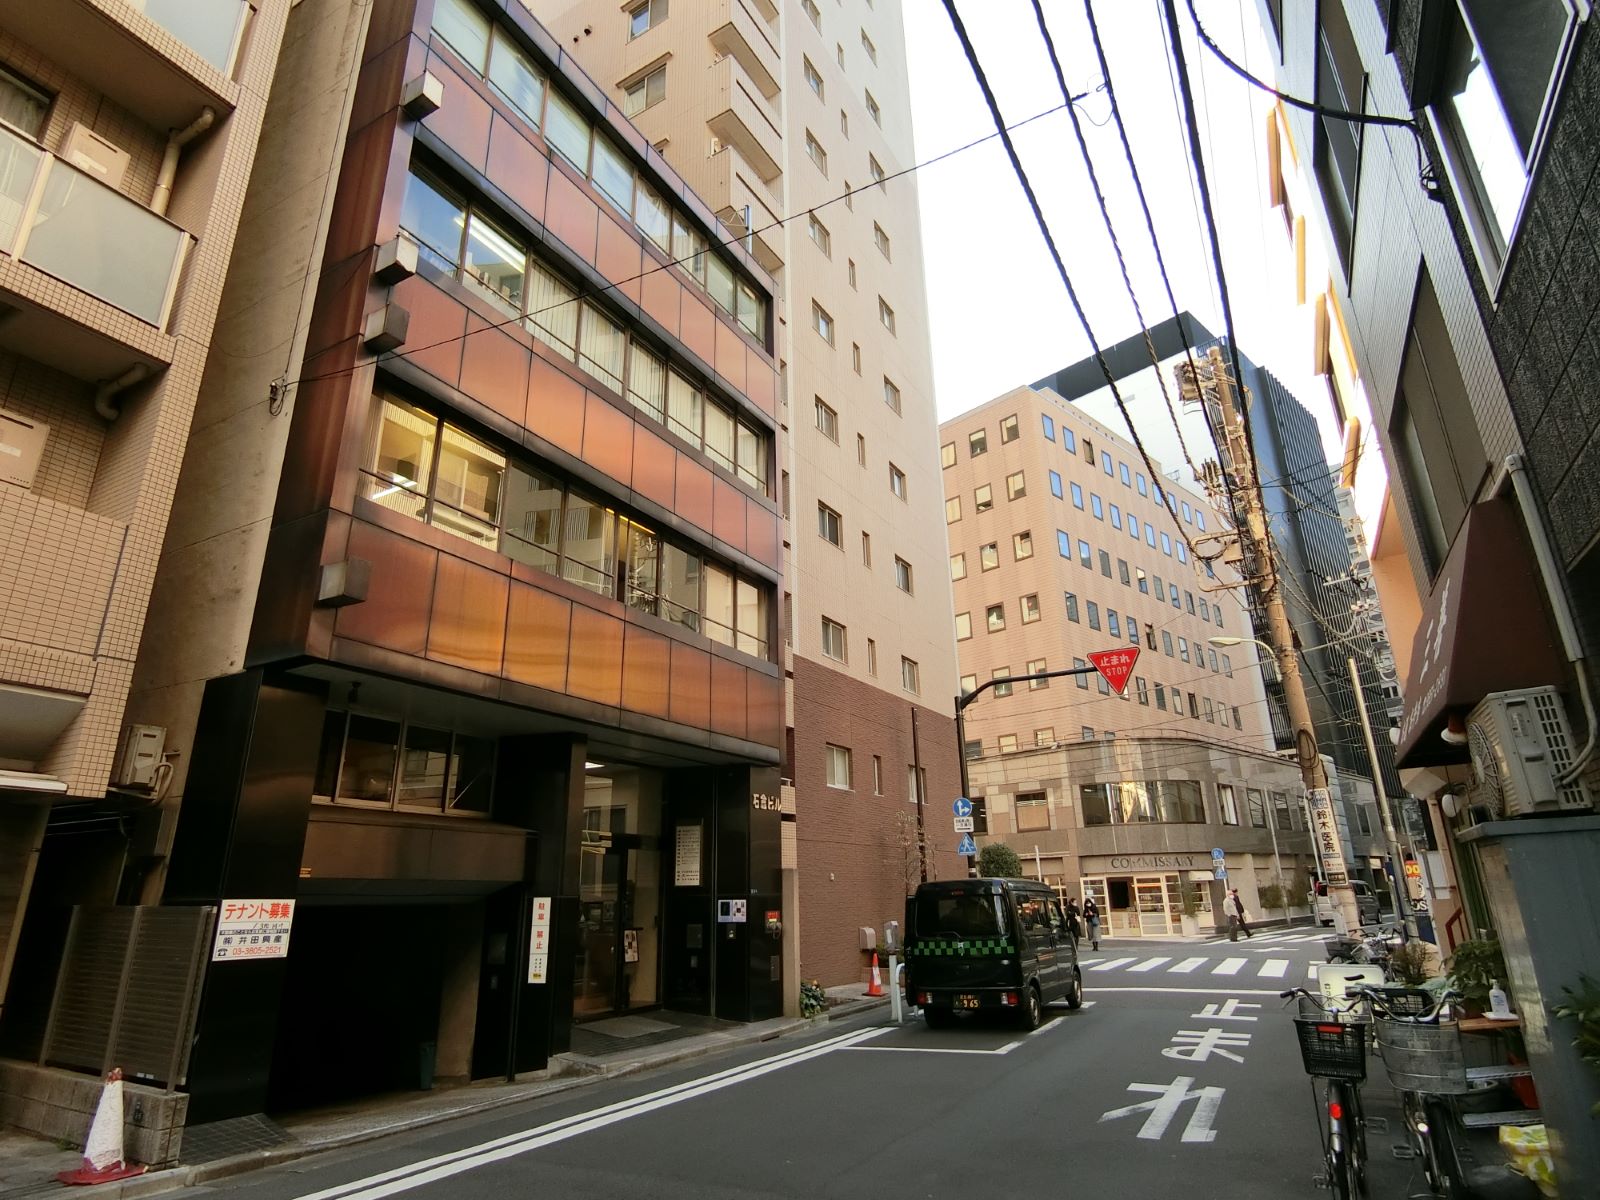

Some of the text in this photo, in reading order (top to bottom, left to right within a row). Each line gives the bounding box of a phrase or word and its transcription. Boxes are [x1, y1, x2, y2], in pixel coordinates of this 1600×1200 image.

[1100, 654, 1130, 667] 止まれ
[1106, 666, 1128, 676] STOP
[1316, 810, 1336, 853] 鈴木医院
[1111, 855, 1194, 869] COMMISSARY
[225, 902, 291, 920] テナント募集
[1097, 998, 1262, 1143] 止まれ
